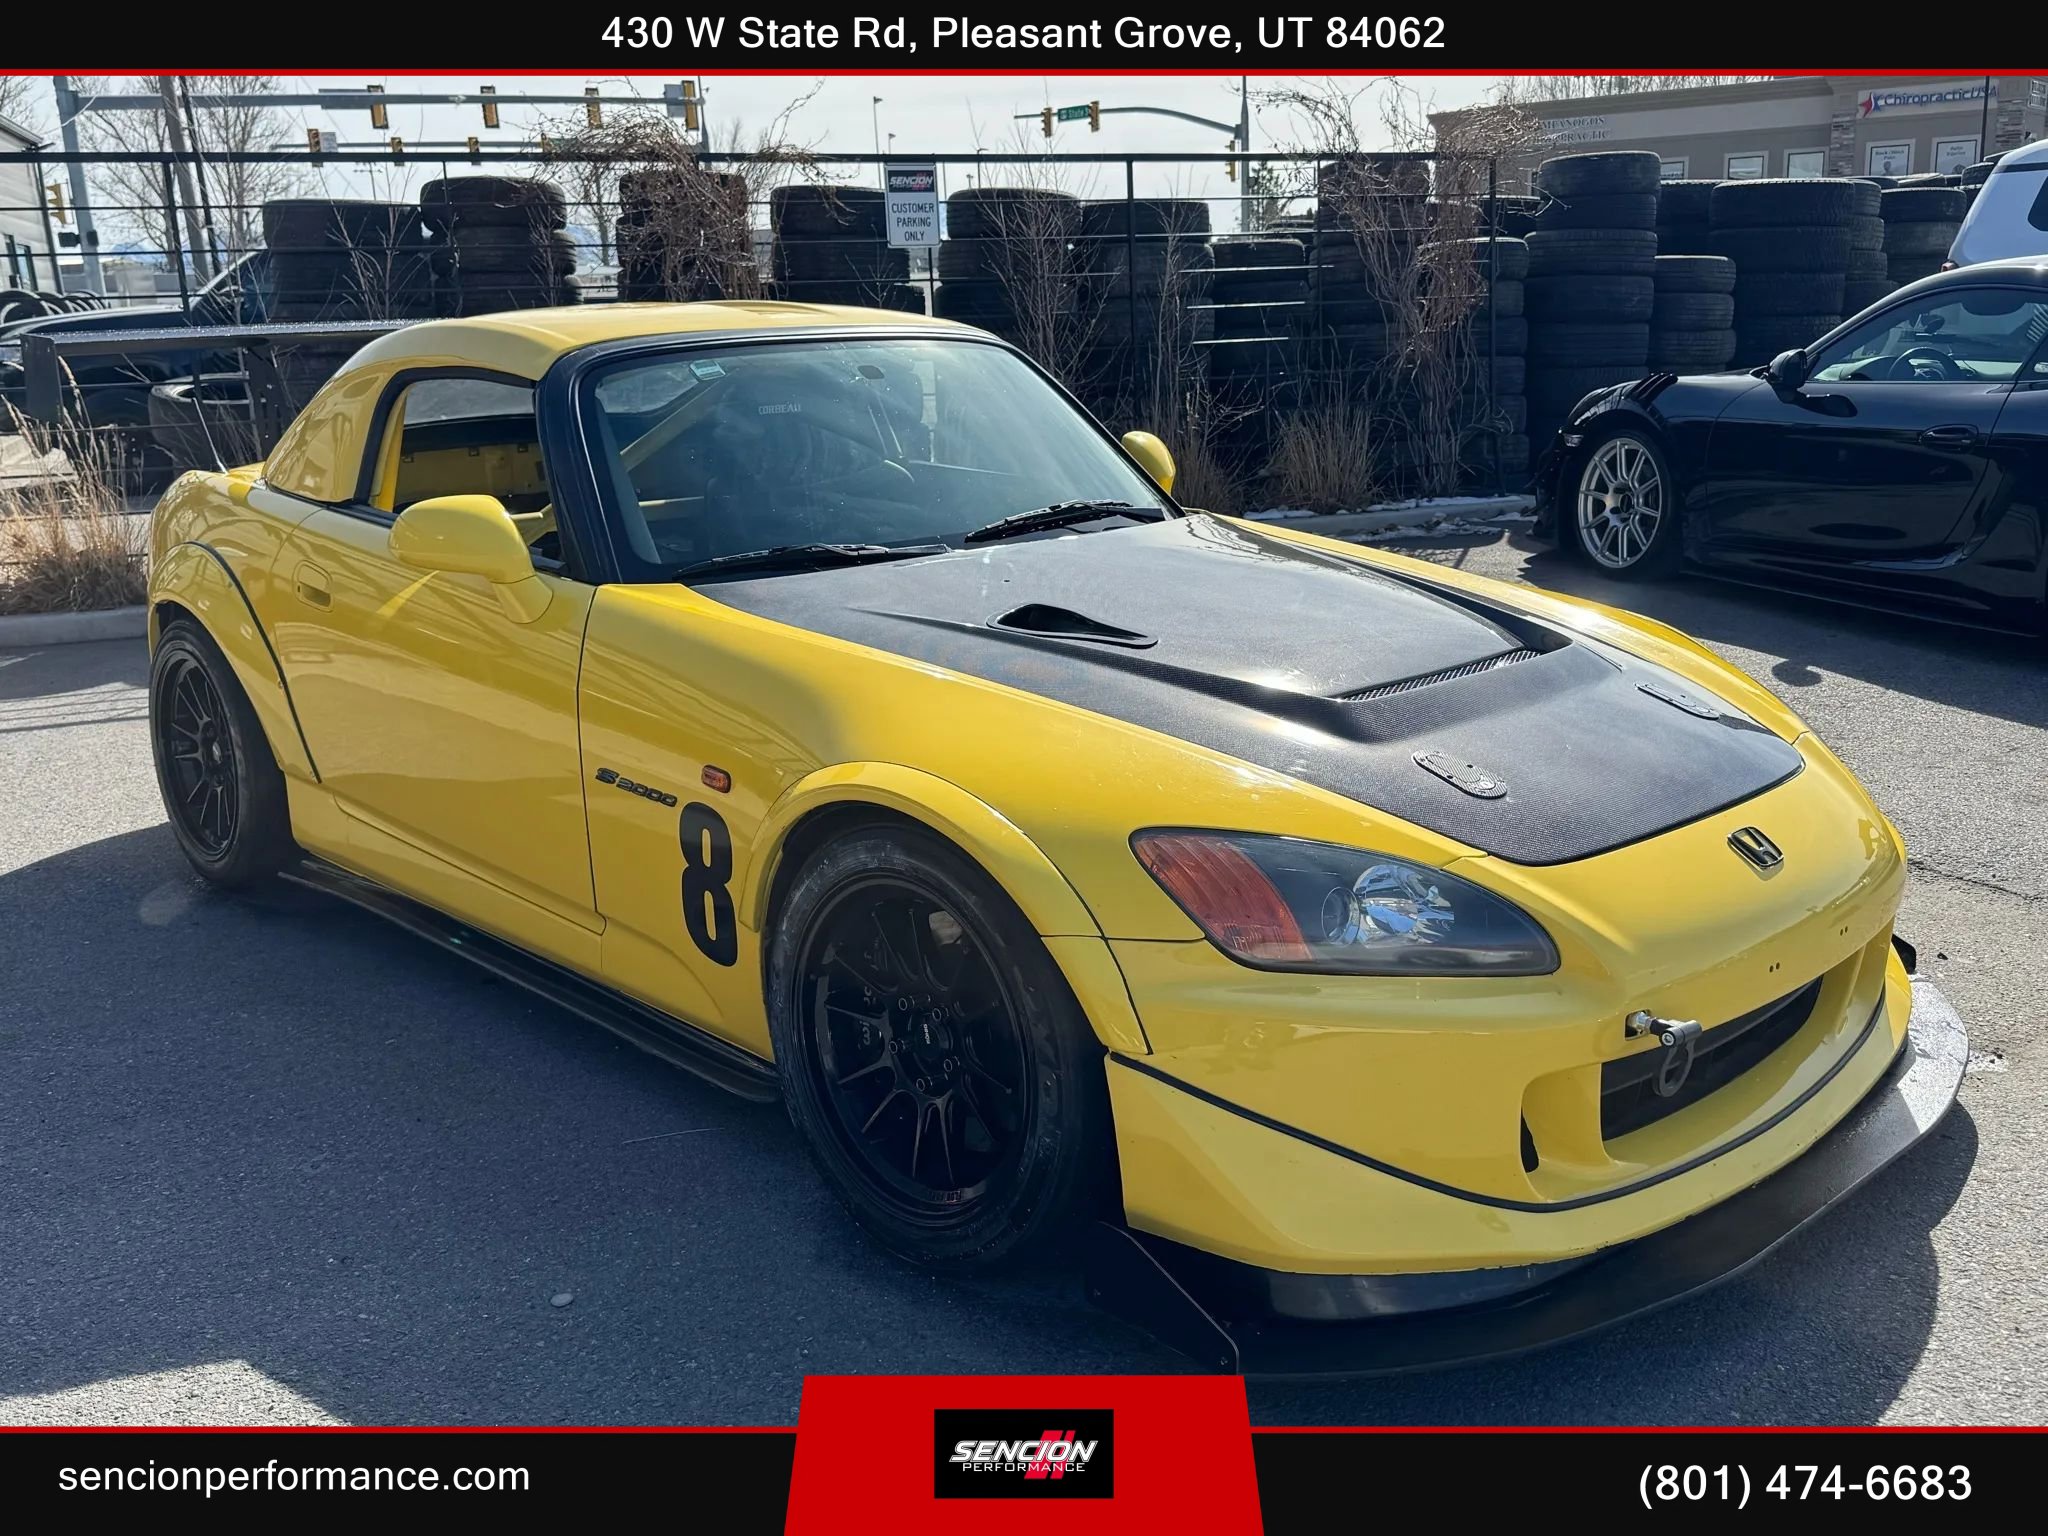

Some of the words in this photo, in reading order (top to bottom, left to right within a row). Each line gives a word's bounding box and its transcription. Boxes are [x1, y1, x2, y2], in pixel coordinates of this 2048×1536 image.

[890, 176, 933, 185] SENCION
[891, 203, 935, 214] CUSTOMER
[896, 217, 931, 228] PARKING
[904, 231, 925, 241] ONLY
[759, 403, 801, 415] CORBEAU
[595, 767, 678, 807] S2000
[679, 801, 739, 967] 8
